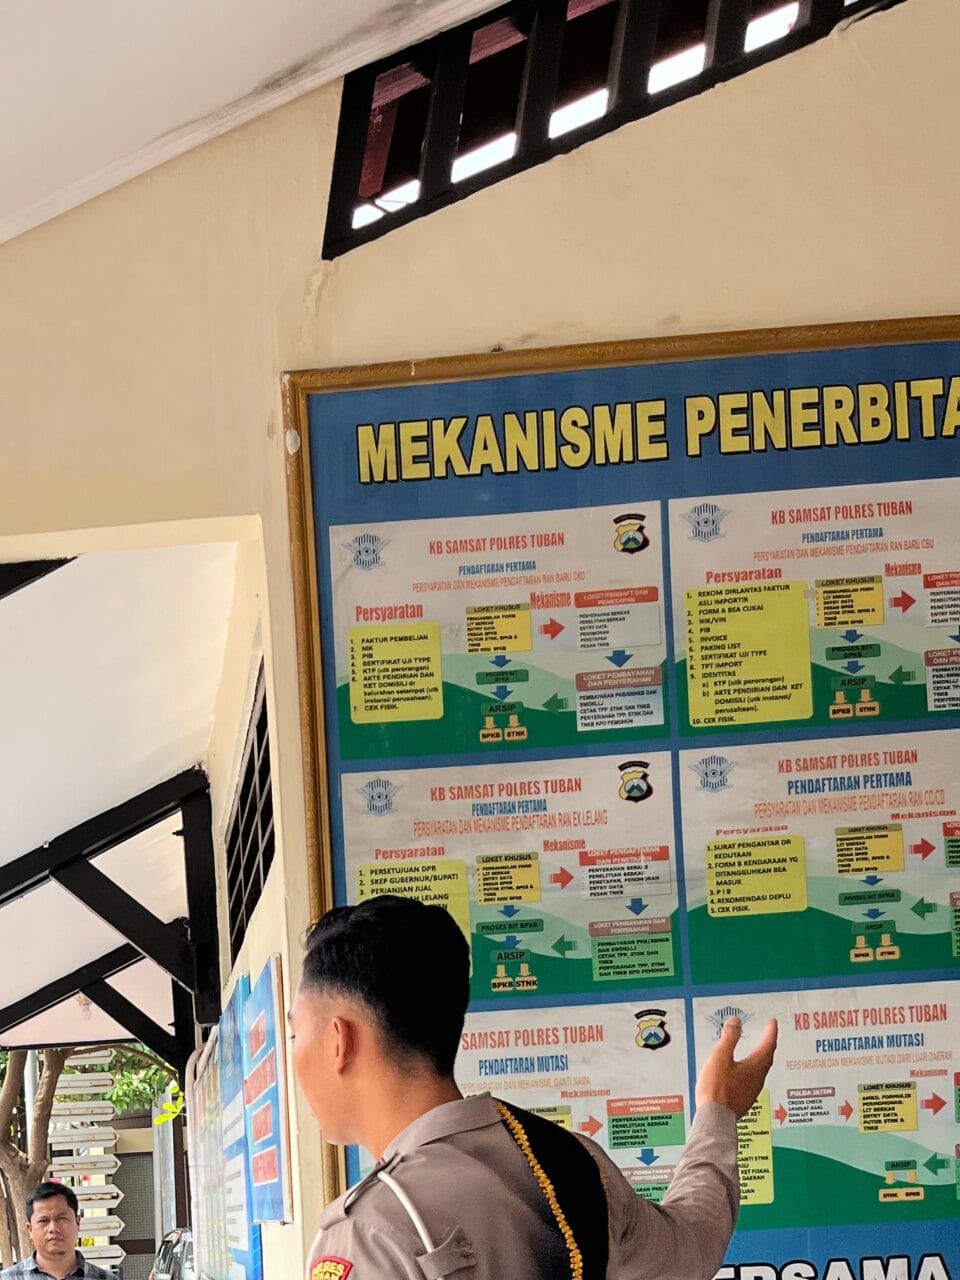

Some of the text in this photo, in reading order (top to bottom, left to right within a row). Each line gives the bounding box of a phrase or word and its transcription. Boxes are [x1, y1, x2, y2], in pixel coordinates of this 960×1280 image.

[356, 399, 668, 483] MEKANISME
[771, 500, 912, 525] KB SAMSAT POLRES TUBAN
[802, 527, 884, 543] PENDAFTARAN PERTAMA
[430, 533, 564, 555] KB SAMSAT POLRES TUBAN
[459, 560, 536, 576] PENDAFTARAN PERTAMA
[706, 567, 782, 584] Persyaratan
[885, 562, 922, 577] Mekanisme
[530, 591, 571, 611] Mekanisme
[356, 604, 424, 622] Persyaratan
[778, 750, 918, 774] KB SAMSAT POLRES TUBAN
[430, 778, 582, 801] KB SAMSAT POLRES TUBAN
[788, 771, 912, 795] PENDAFTARAN PERTAMA
[472, 799, 547, 816] PENDAFTARAN PERTAMA
[891, 809, 956, 821] Mekanisme
[375, 845, 445, 860] Persyaratan
[543, 838, 586, 851] Mekanisme
[738, 840, 780, 848] PENGANTAR
[370, 867, 419, 876] PERSETUJUAN
[390, 874, 458, 883] GUBERNUR/BUPATI
[371, 887, 413, 895] PERJANJIAN
[497, 952, 525, 961] ARSIP
[492, 980, 513, 988] BPKB
[794, 1003, 947, 1030] KB SAMSAT POLRES TUBAN
[462, 1024, 604, 1050] SAMSAT POLRES TUBAN
[816, 1032, 924, 1053] PENDAFTARAN MUTASI
[479, 1054, 568, 1076] PENDAFTARAN MUTASI
[560, 1088, 611, 1099] Mekanisme
